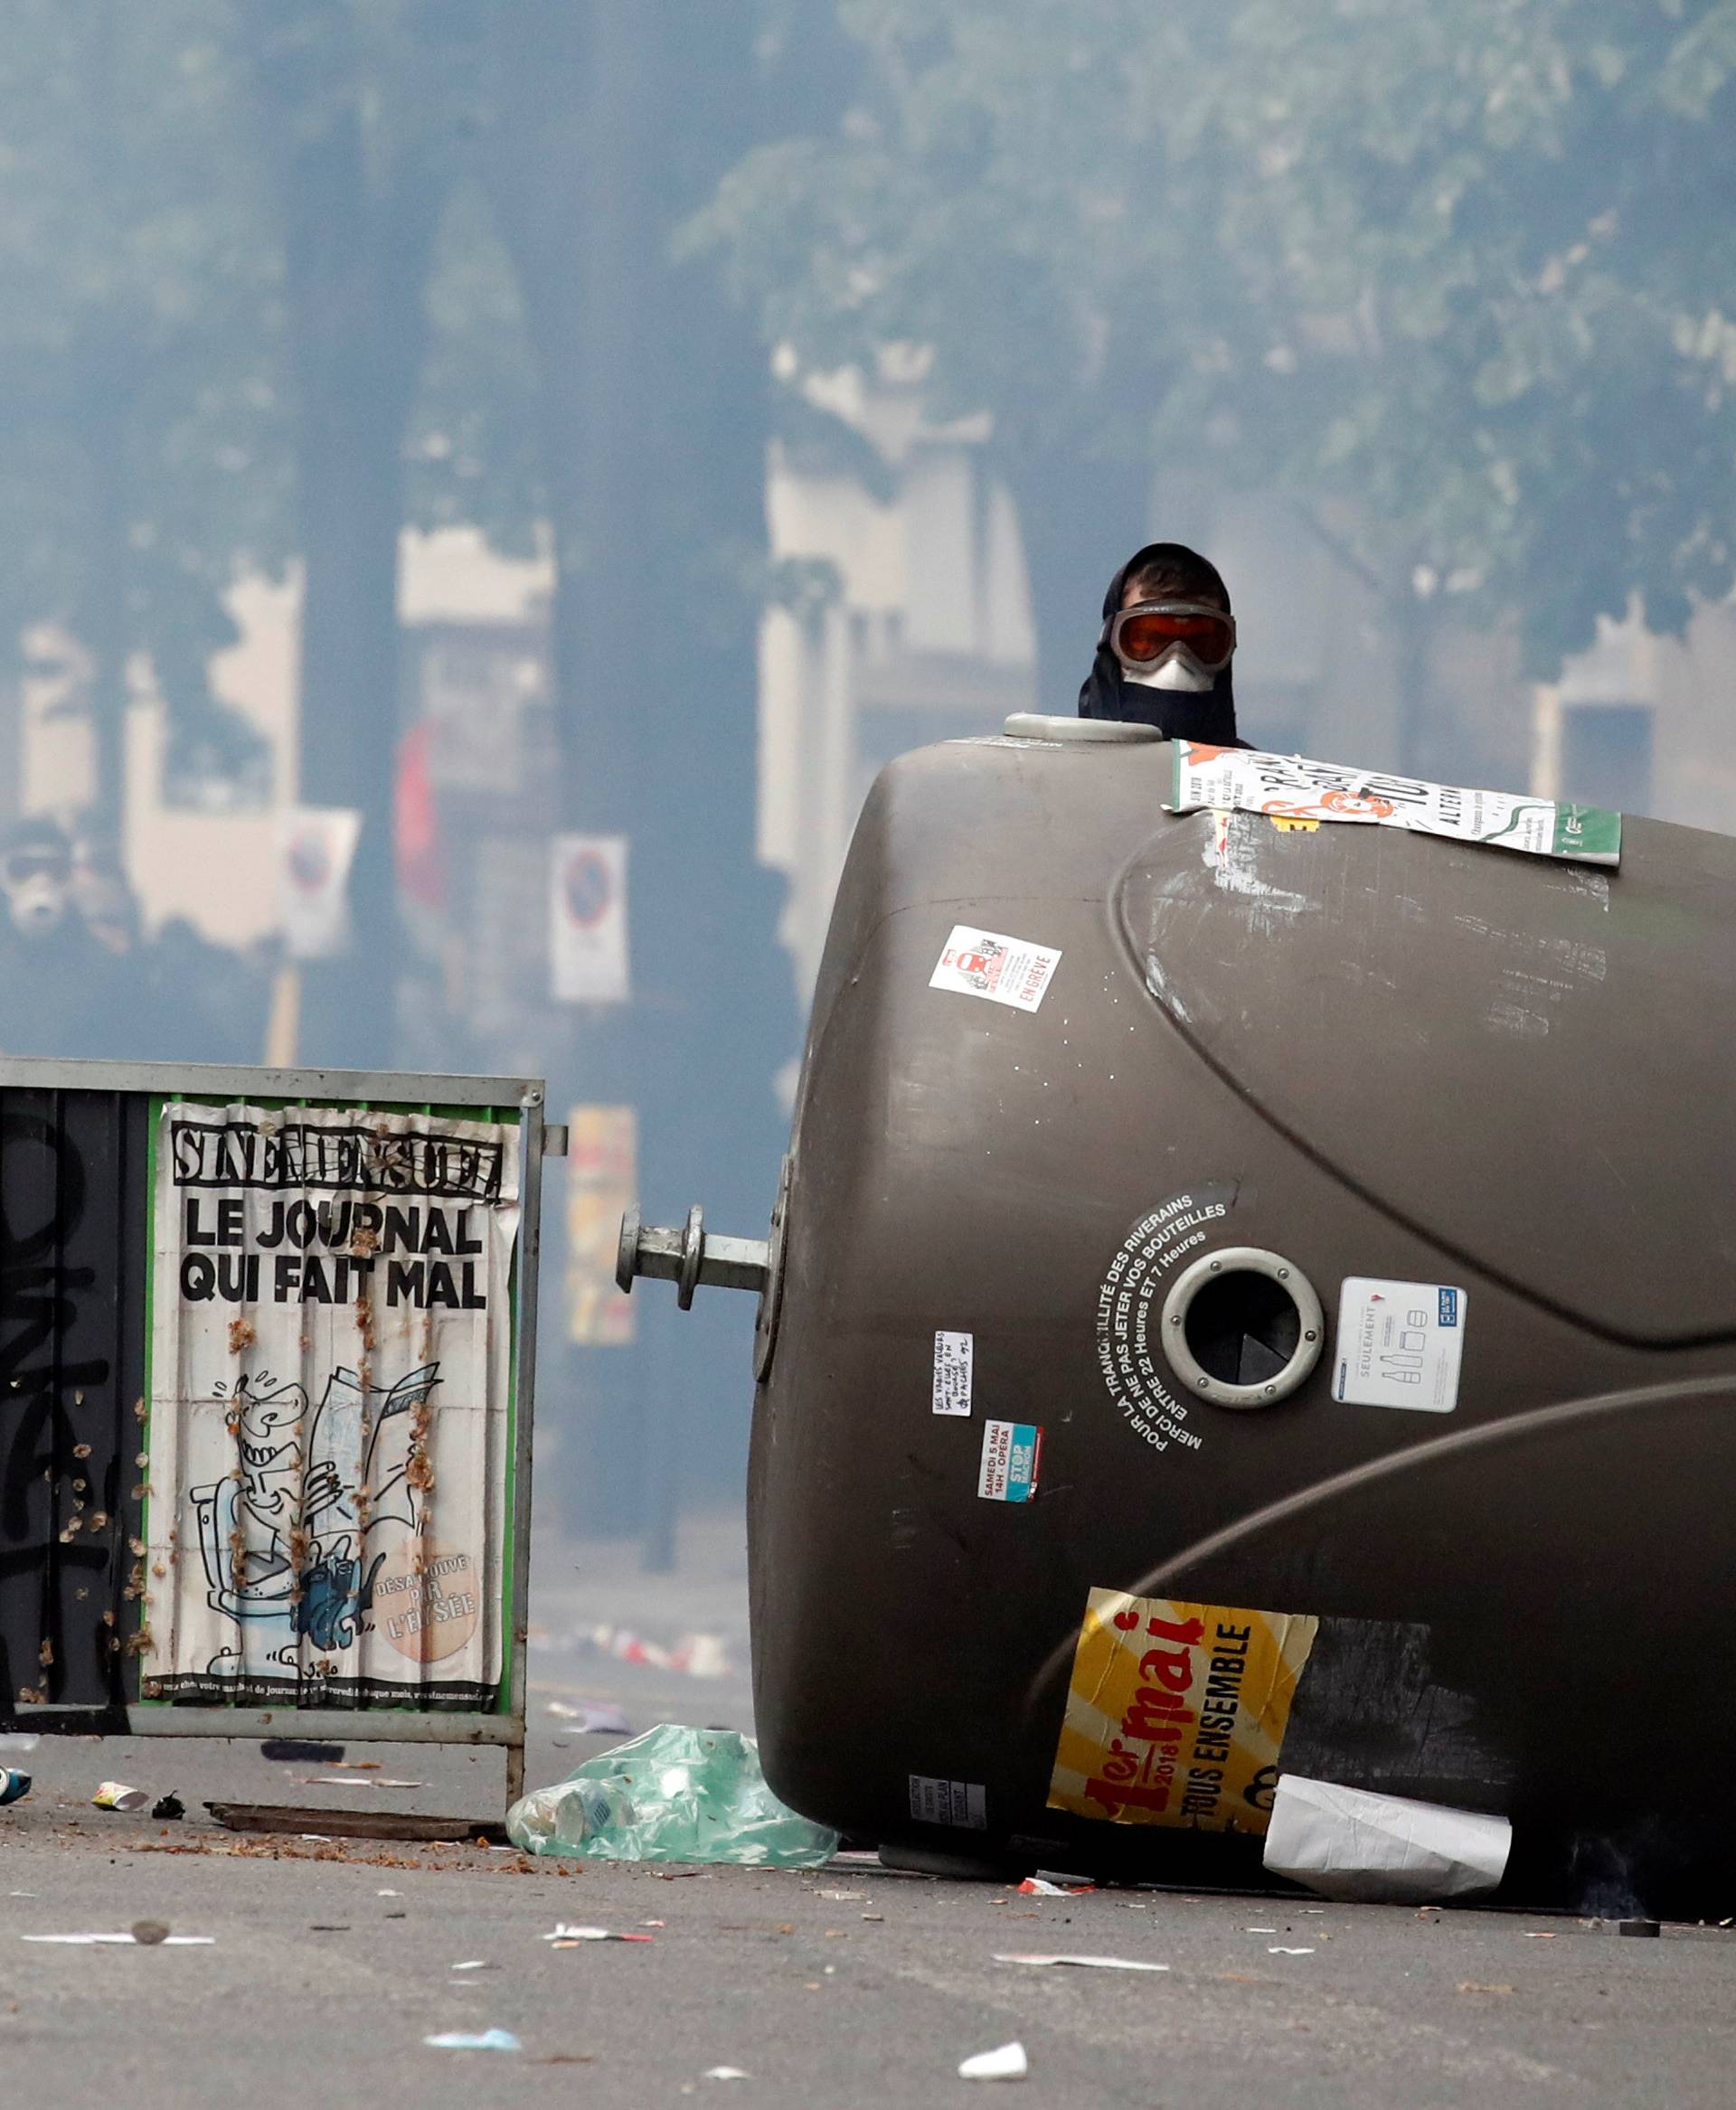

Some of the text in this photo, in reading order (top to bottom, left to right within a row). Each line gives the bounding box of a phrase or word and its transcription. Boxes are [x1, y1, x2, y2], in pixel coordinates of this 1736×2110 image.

[1020, 987, 1036, 1002] EN
[186, 1198, 482, 1255] LE JOURNAL
[1124, 1194, 1194, 1253] RIVERAINS
[181, 1252, 486, 1309] QUI FAIT MAL
[1107, 1251, 1129, 1283] DES
[1115, 1203, 1226, 1450] MERCI DE NE PAS JETER VOS BOUTEILLES
[1134, 1230, 1206, 1421] ENTRE 22 Heures ET 7 Heures
[1360, 1306, 1377, 1378] SEULEMENT
[1118, 1395, 1135, 1418] LA
[990, 1425, 1000, 1445] MAI
[1130, 1414, 1168, 1452] POUR
[985, 1457, 996, 1496] SAMEDI
[995, 1474, 1004, 1493] 14H
[1010, 1445, 1024, 1482] STOP
[1085, 1611, 1206, 1817] 1er mai
[1179, 1624, 1251, 1817] TOUS ENSEMBLE
[1155, 1745, 1180, 1785] 2018
